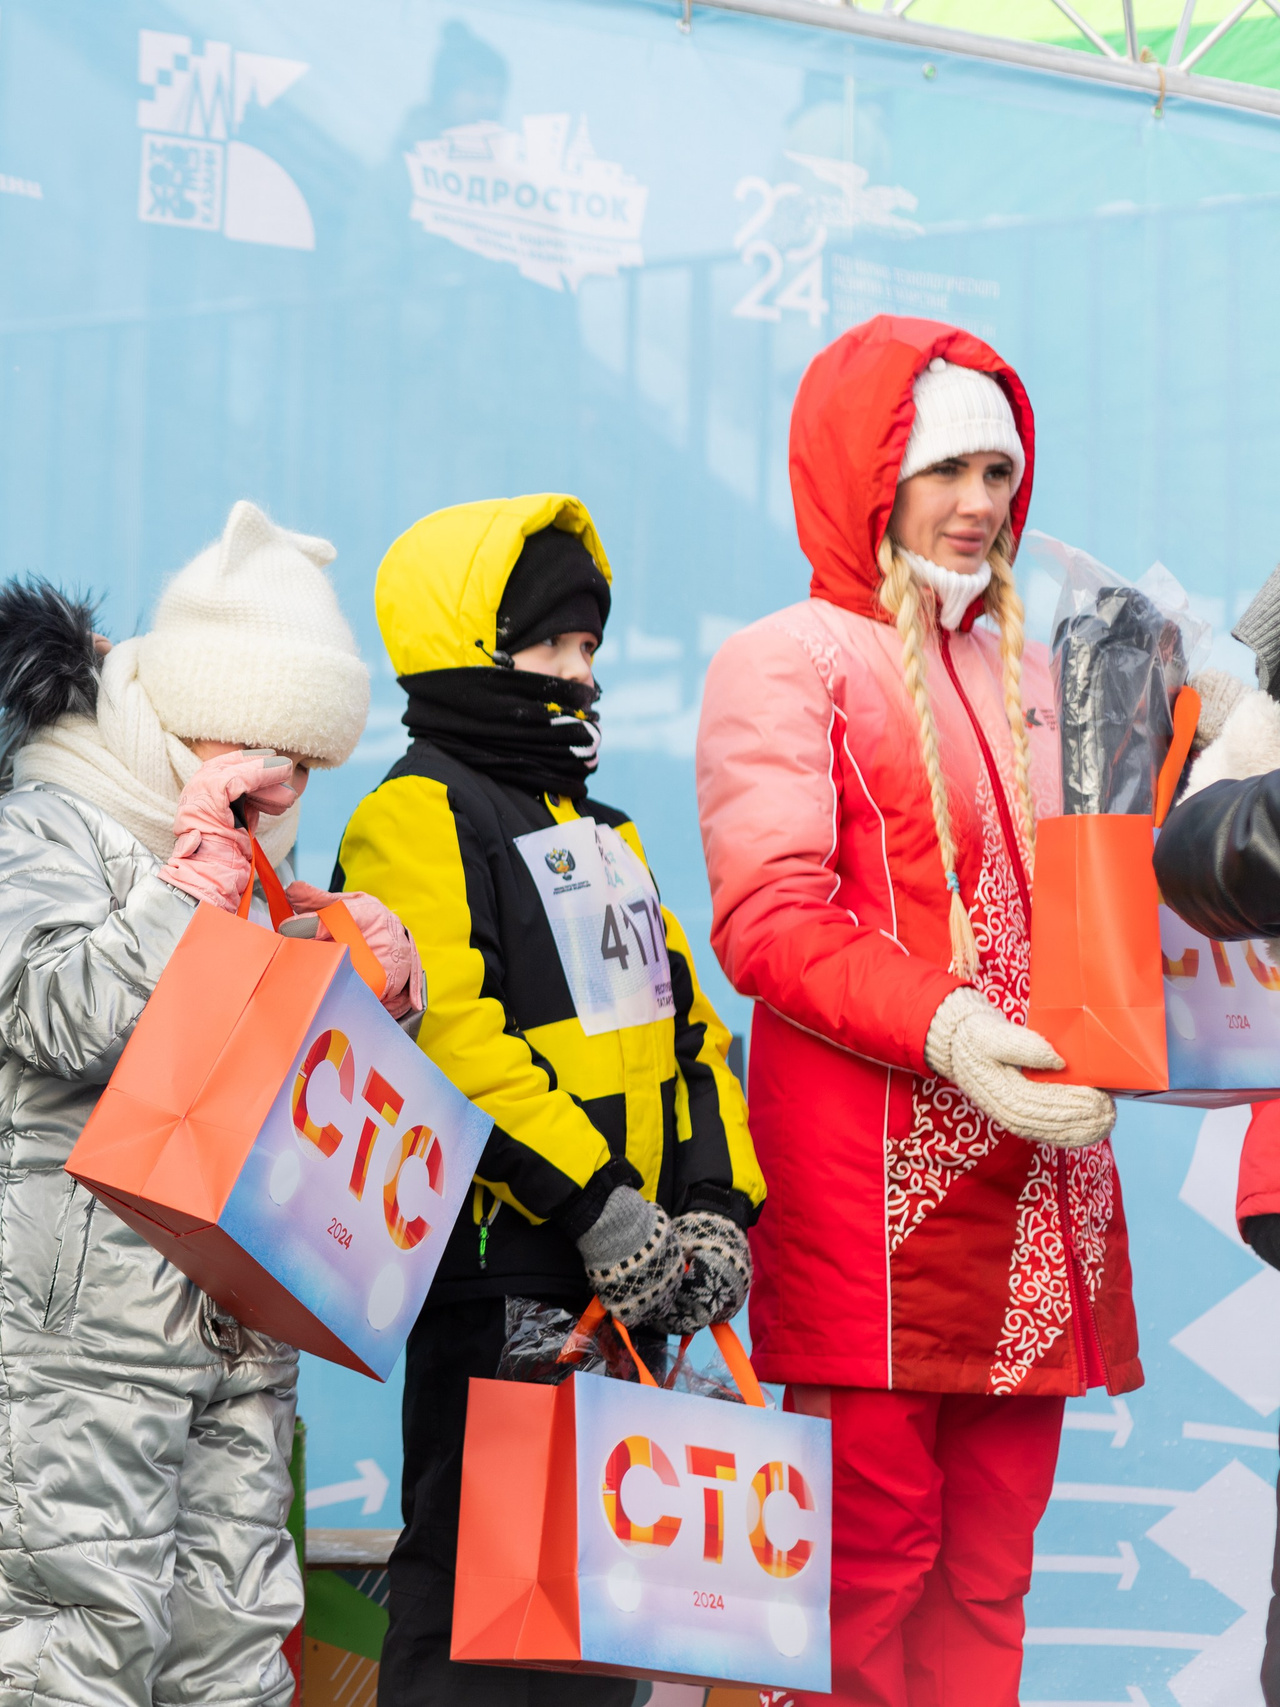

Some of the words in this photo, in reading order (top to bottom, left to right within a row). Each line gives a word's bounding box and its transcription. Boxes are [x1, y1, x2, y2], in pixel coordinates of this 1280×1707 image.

[422, 164, 629, 223] ПОДРОСТОК
[1225, 1014, 1251, 1030] 2024
[289, 1028, 446, 1255] СТС
[326, 1217, 354, 1250] 2024
[599, 1435, 819, 1582] СТС
[692, 1590, 725, 1611] 2024
